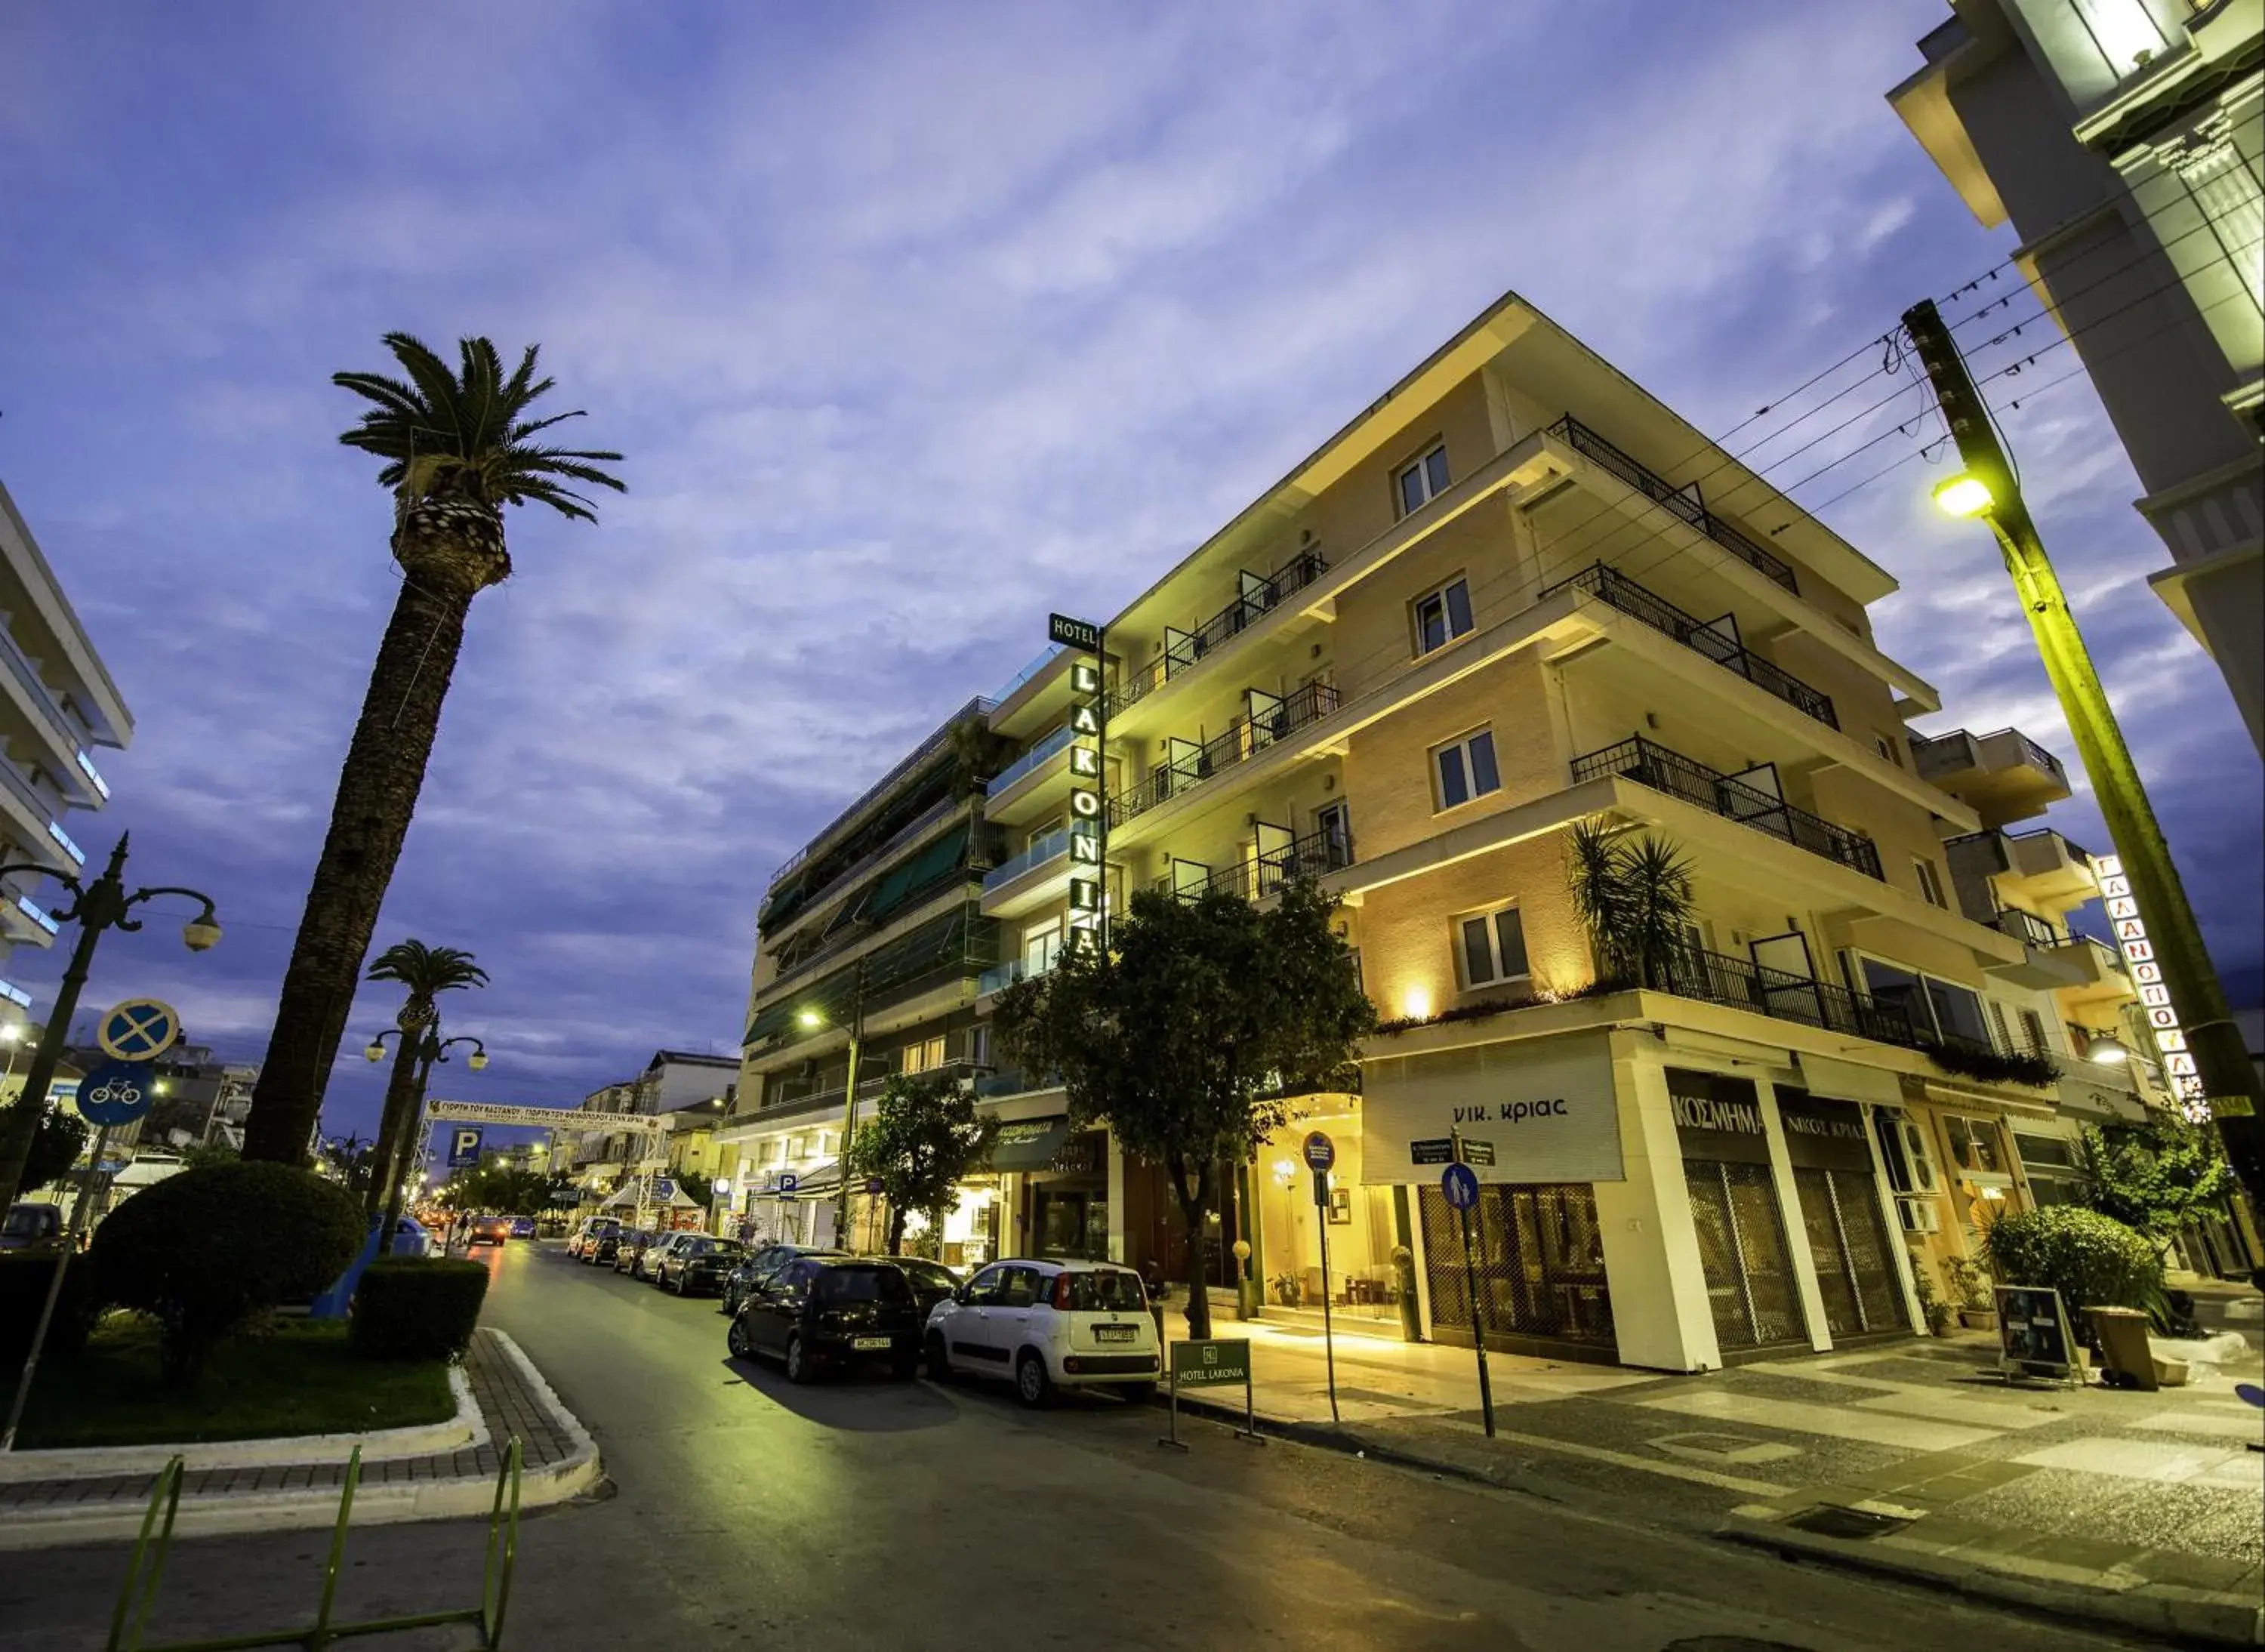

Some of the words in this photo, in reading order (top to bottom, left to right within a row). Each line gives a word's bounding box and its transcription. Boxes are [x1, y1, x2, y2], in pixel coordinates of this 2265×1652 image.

[1054, 619, 1096, 644] HOTEL
[1074, 666, 1098, 956] LAKONIA
[456, 1132, 478, 1156] P
[783, 1176, 792, 1189] P
[1180, 1370, 1206, 1381] HOTEL
[1209, 1367, 1244, 1380] LAKONIA
